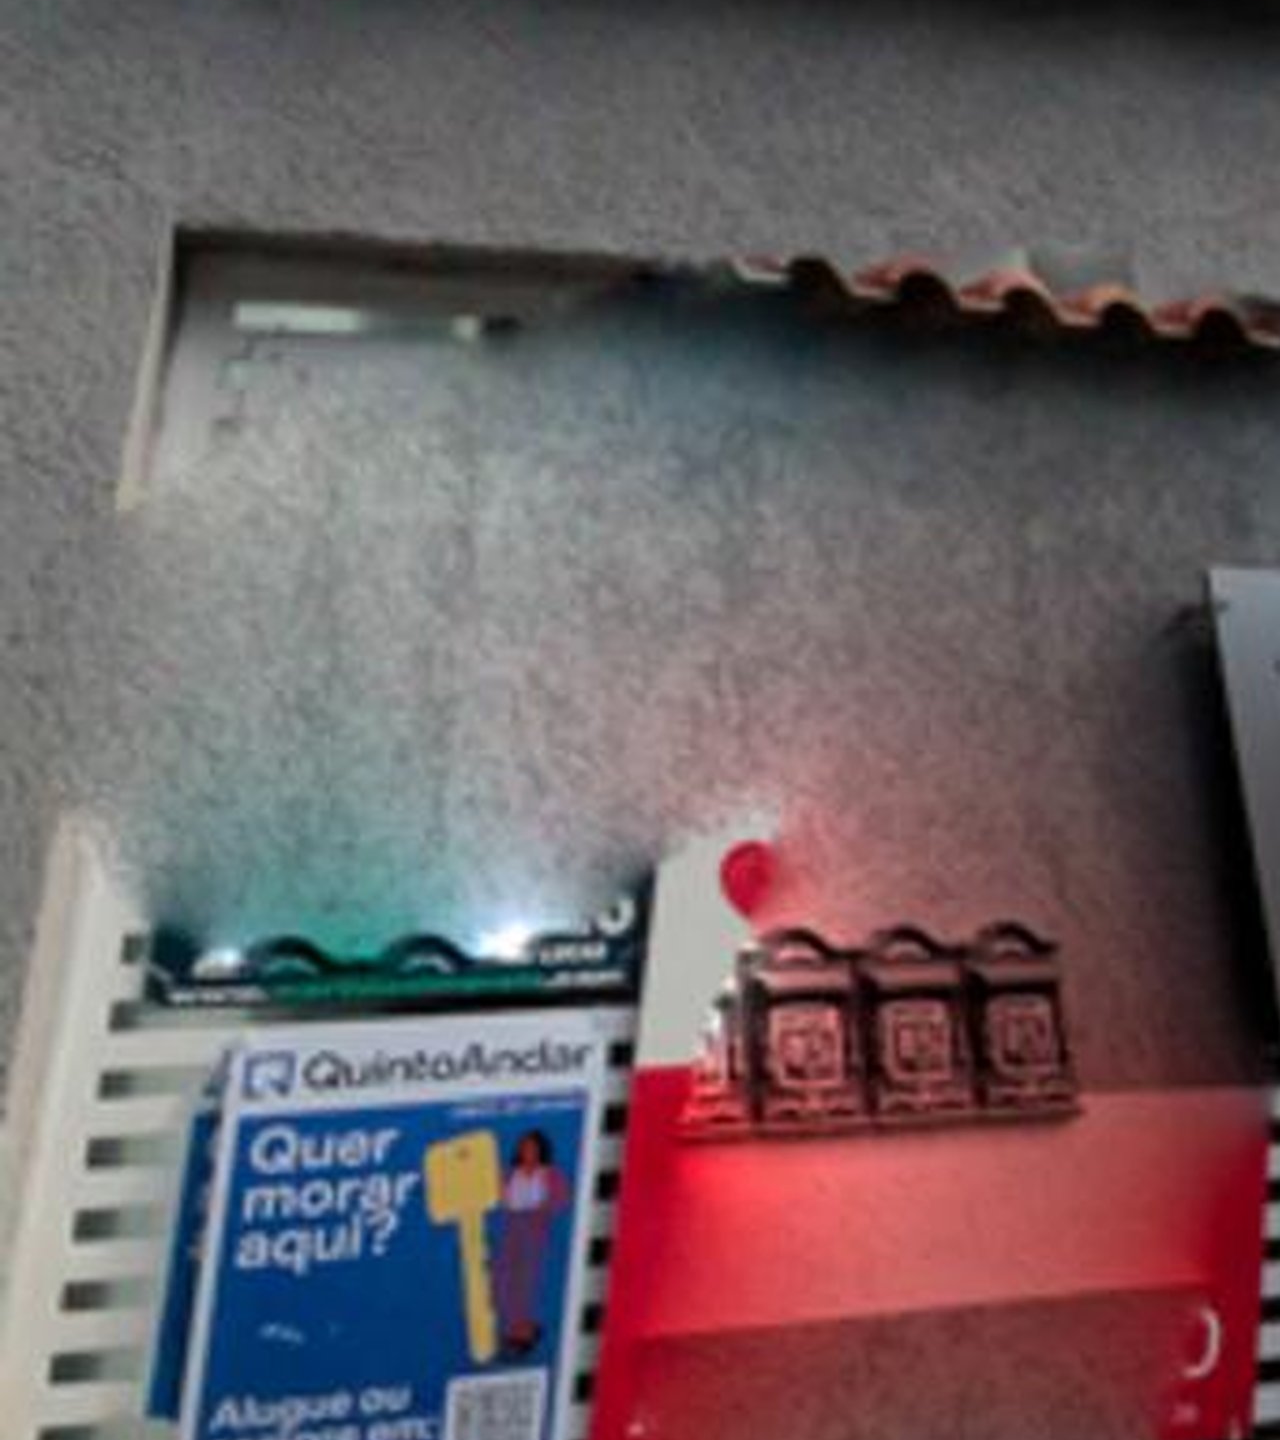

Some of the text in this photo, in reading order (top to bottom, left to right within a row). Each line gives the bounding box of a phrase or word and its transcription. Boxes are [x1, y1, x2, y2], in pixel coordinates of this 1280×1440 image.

[301, 1041, 594, 1089] QuintoAndar
[250, 1124, 400, 1175] Quer
[243, 1169, 420, 1222] morar
[234, 1210, 398, 1274] aqui?
[208, 1385, 413, 1437] Alugue ou
